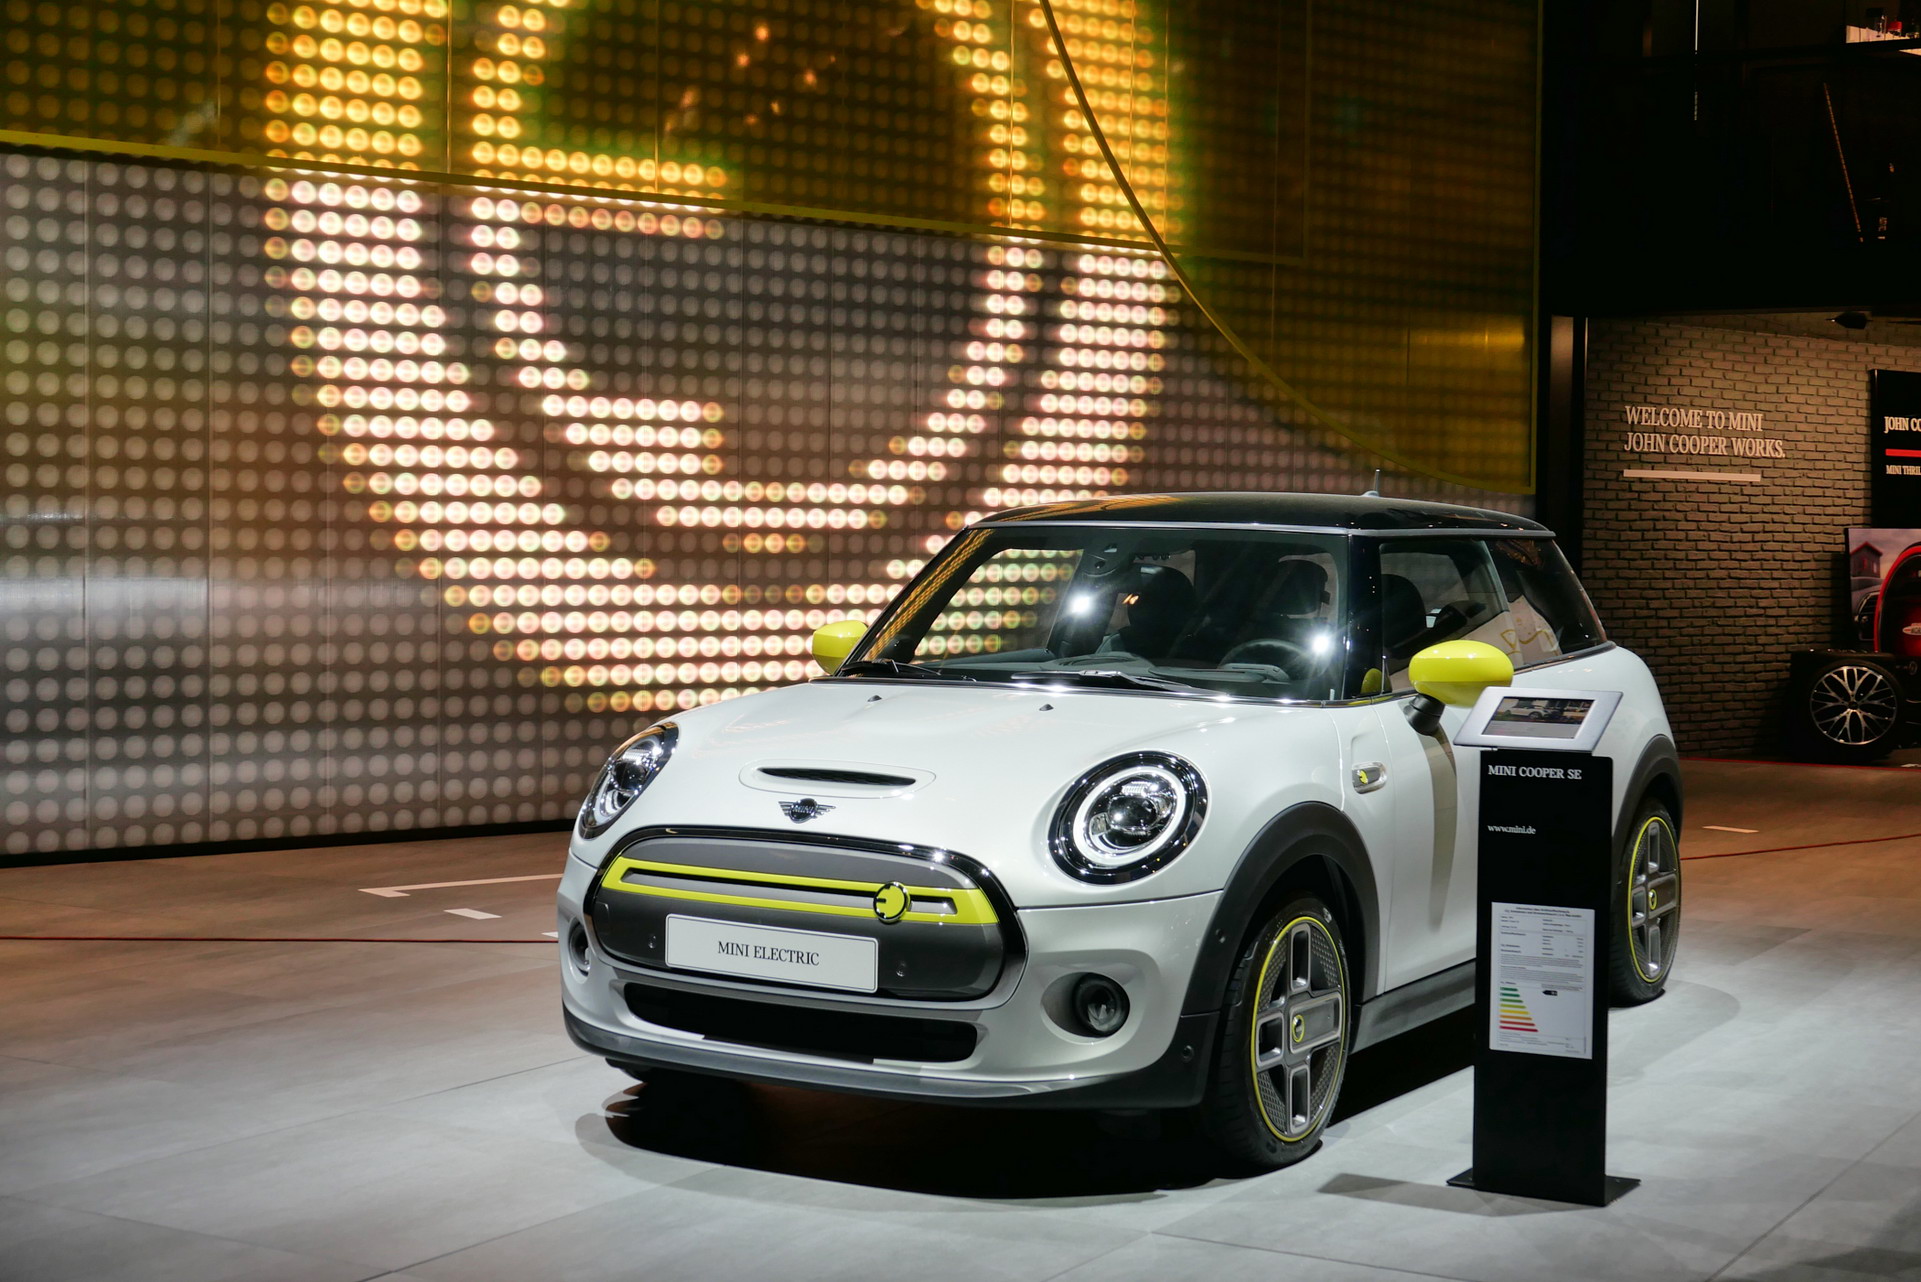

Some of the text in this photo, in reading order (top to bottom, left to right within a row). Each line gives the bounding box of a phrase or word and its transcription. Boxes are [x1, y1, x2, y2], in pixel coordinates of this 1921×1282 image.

[1625, 405, 1764, 432] WELCOME TO MINI
[1883, 416, 1909, 434] JOHN
[1624, 432, 1786, 458] JOHN COOPER WORKS.
[1886, 465, 1902, 475] MINI
[1488, 765, 1582, 780] MINI COOPER SE
[1487, 825, 1536, 834] www.mini.de
[718, 941, 820, 966] MINI ELECTRIC
